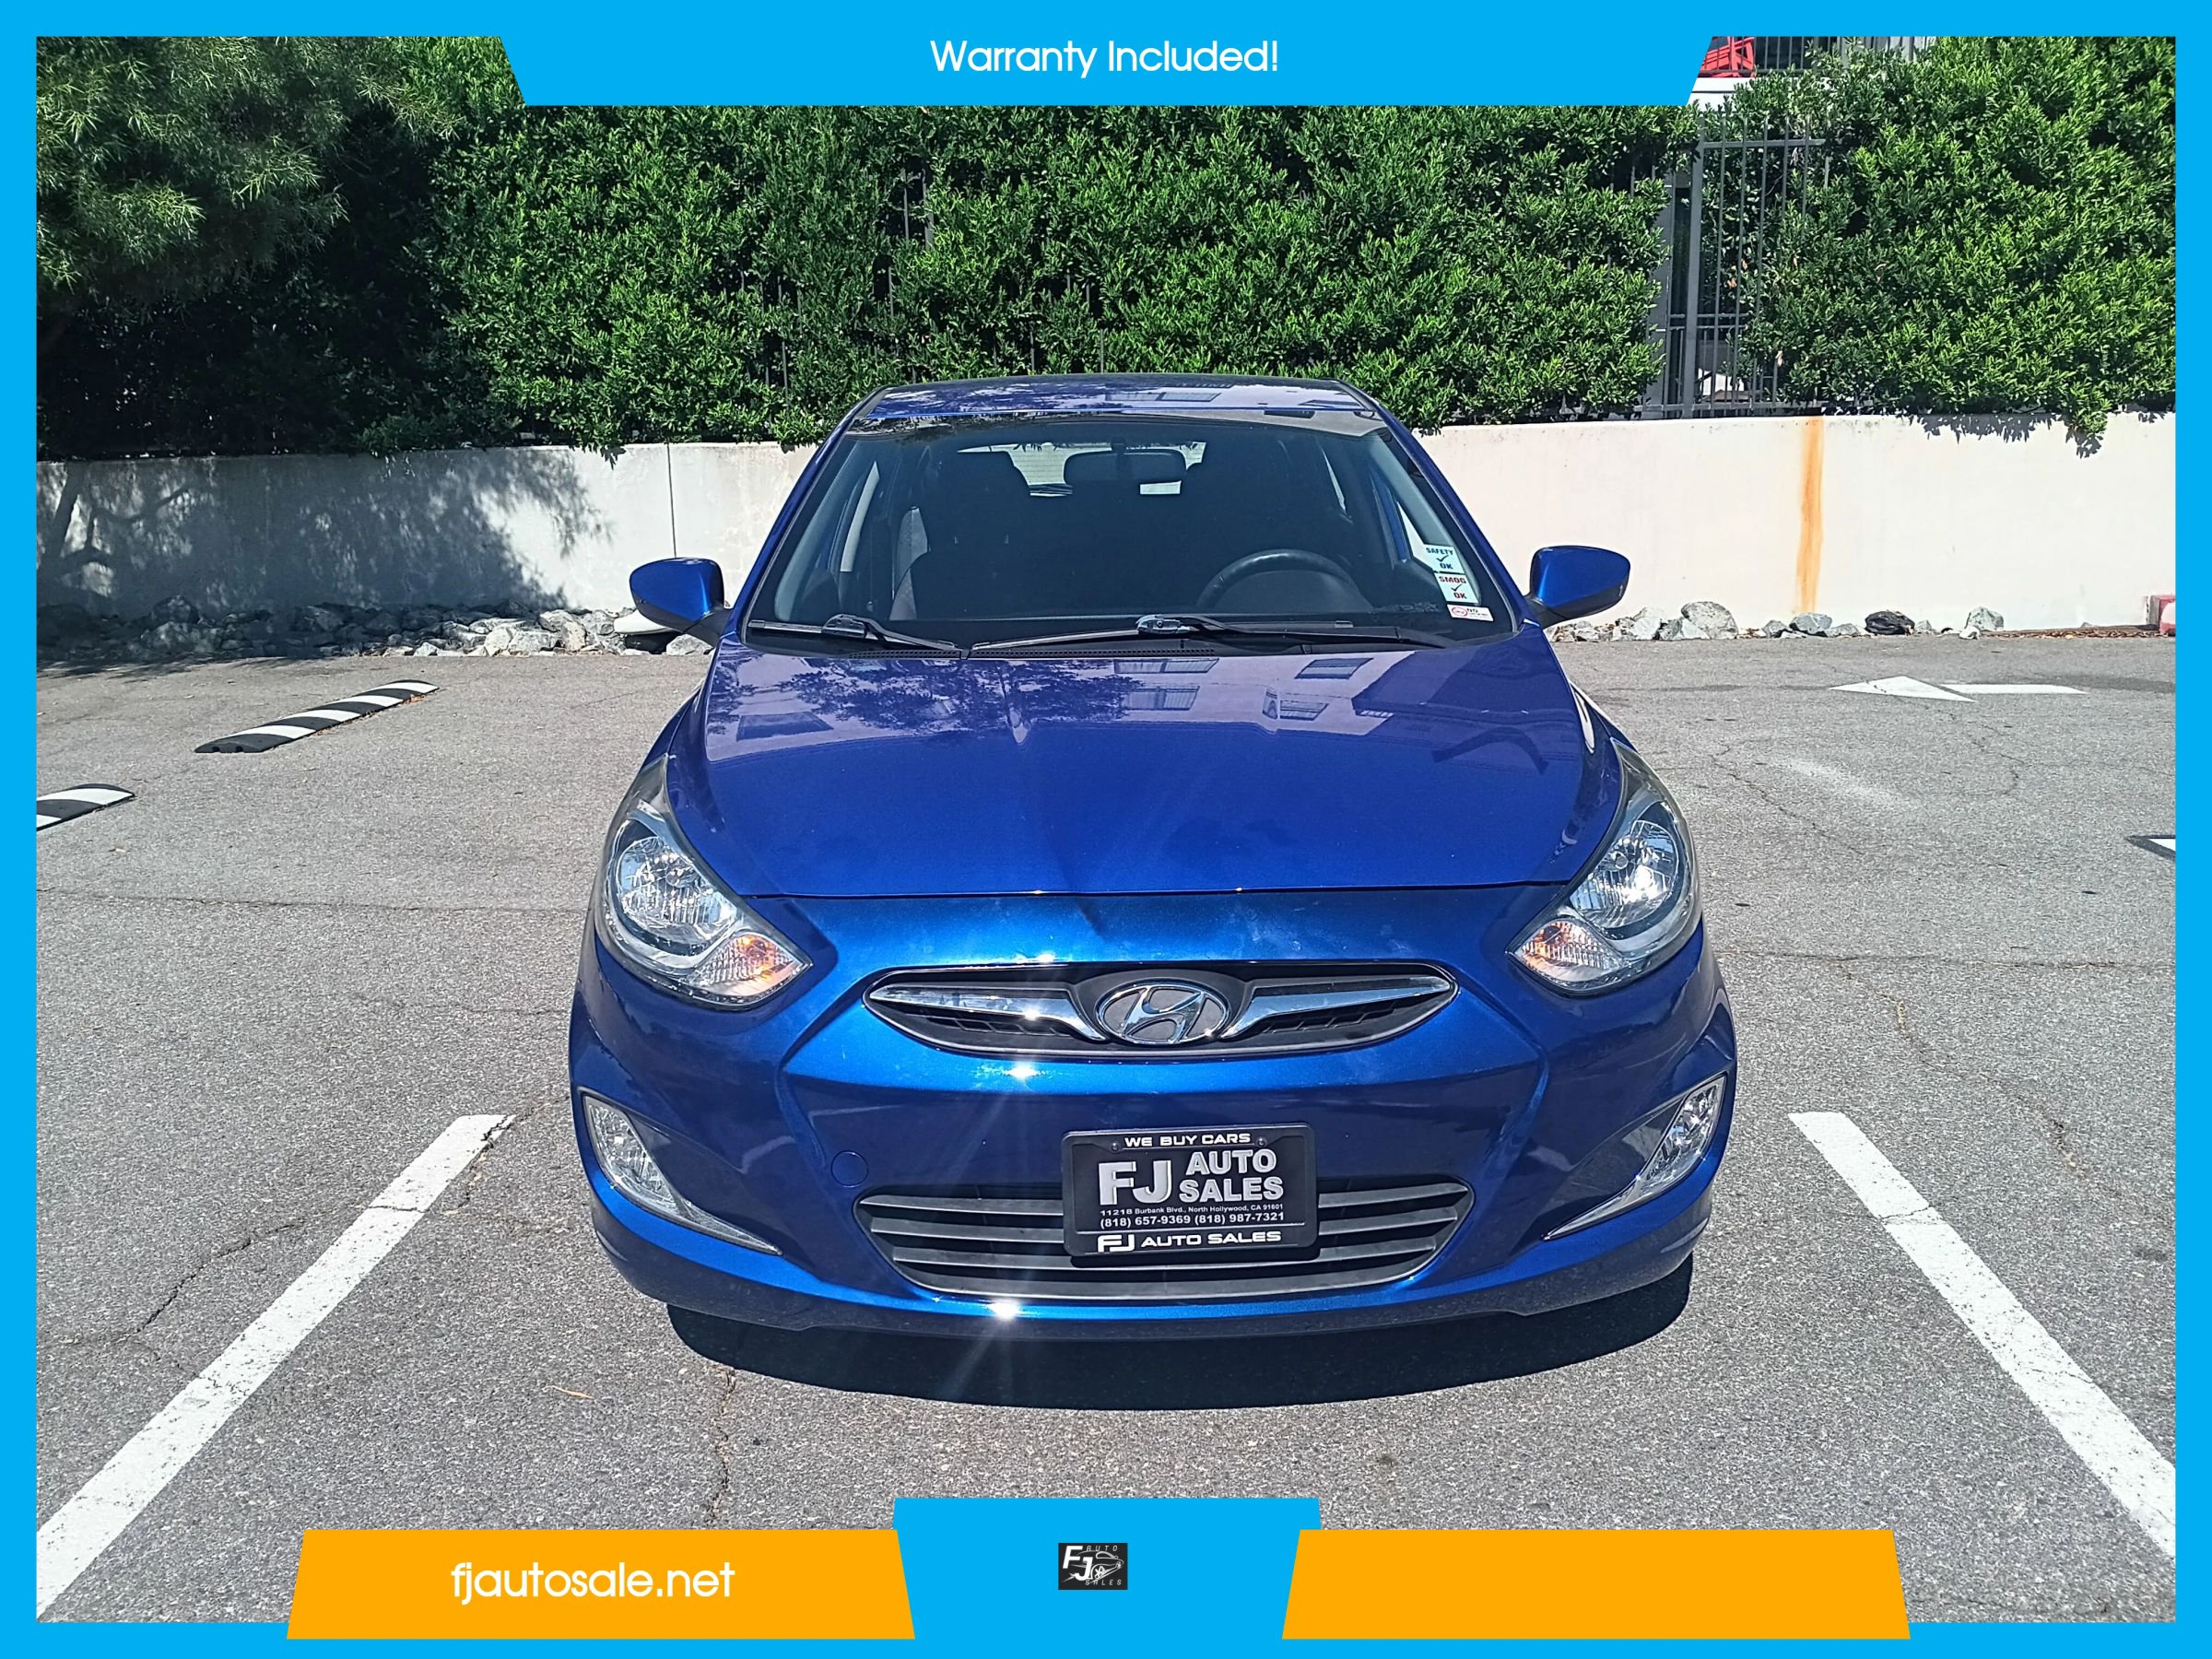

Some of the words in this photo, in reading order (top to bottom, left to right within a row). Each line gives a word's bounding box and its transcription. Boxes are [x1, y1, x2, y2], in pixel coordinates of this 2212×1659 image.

[1426, 547, 1453, 556] SAFETY
[1439, 576, 1467, 584] SMOG
[1124, 1137, 1153, 1147] WE
[1159, 1135, 1197, 1147] BUY
[1202, 1134, 1251, 1145] CARS
[1185, 1148, 1277, 1176] AUTO
[1098, 1159, 1172, 1206] FJ
[1179, 1176, 1284, 1203] SALES
[1209, 1205, 1249, 1213] Hollywood,
[1100, 1217, 1132, 1230] (818)
[1135, 1215, 1191, 1226] 657-9369
[1194, 1214, 1226, 1226] (818)
[1229, 1211, 1284, 1223] 987-7321
[1098, 1234, 1135, 1253] FJ
[1140, 1234, 1202, 1248] AUTO
[1207, 1230, 1282, 1244] SALES
